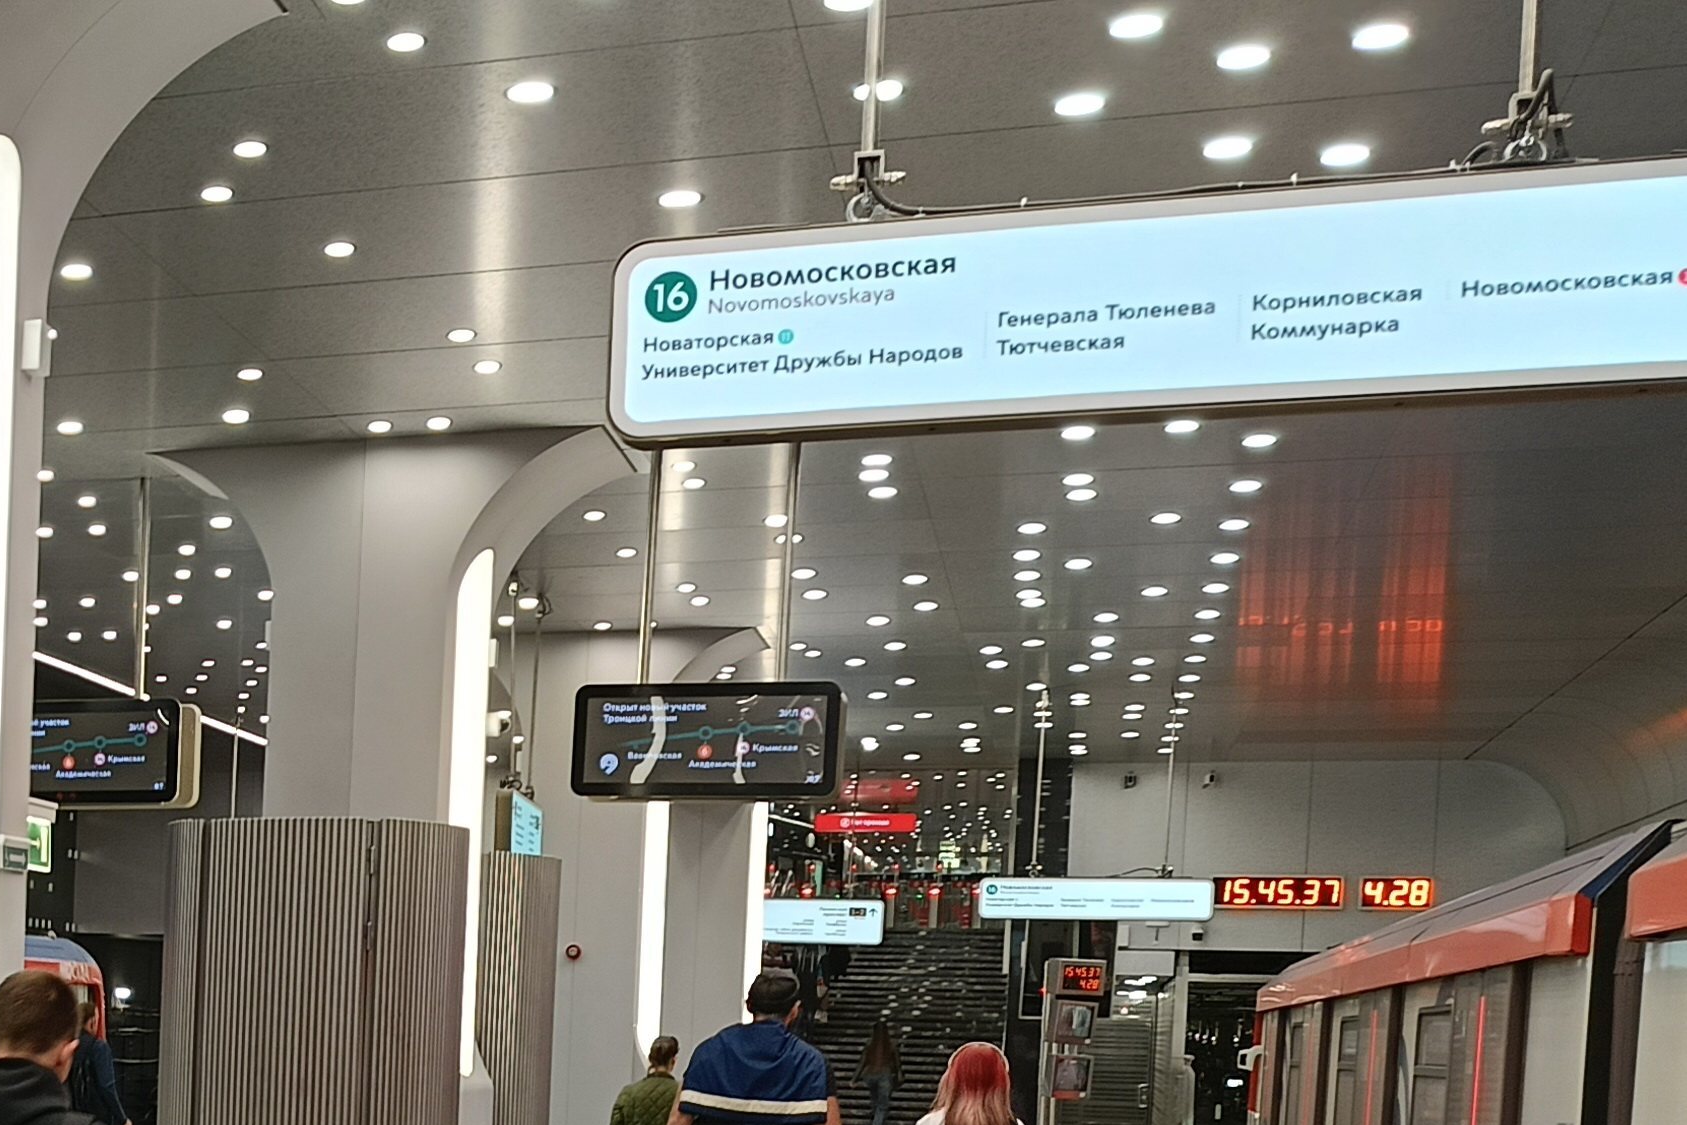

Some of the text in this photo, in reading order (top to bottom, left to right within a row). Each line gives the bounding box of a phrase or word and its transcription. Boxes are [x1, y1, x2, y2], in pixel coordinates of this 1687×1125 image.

[709, 255, 957, 291] Новомосковская
[1461, 268, 1674, 298] Новомосковская
[652, 281, 690, 313] 16
[707, 286, 896, 314] Novomoskovskaya
[1251, 286, 1423, 312] Корниловская
[997, 299, 1217, 329] Генерала Тюленева
[643, 332, 774, 352] Новаторская
[1251, 316, 1400, 342] Коммунарка
[996, 333, 1125, 357] Тютчевская
[641, 343, 964, 381] Университет Дружбы Народов
[1222, 878, 1341, 905] 15.45.37
[1363, 879, 1431, 906] 4.28
